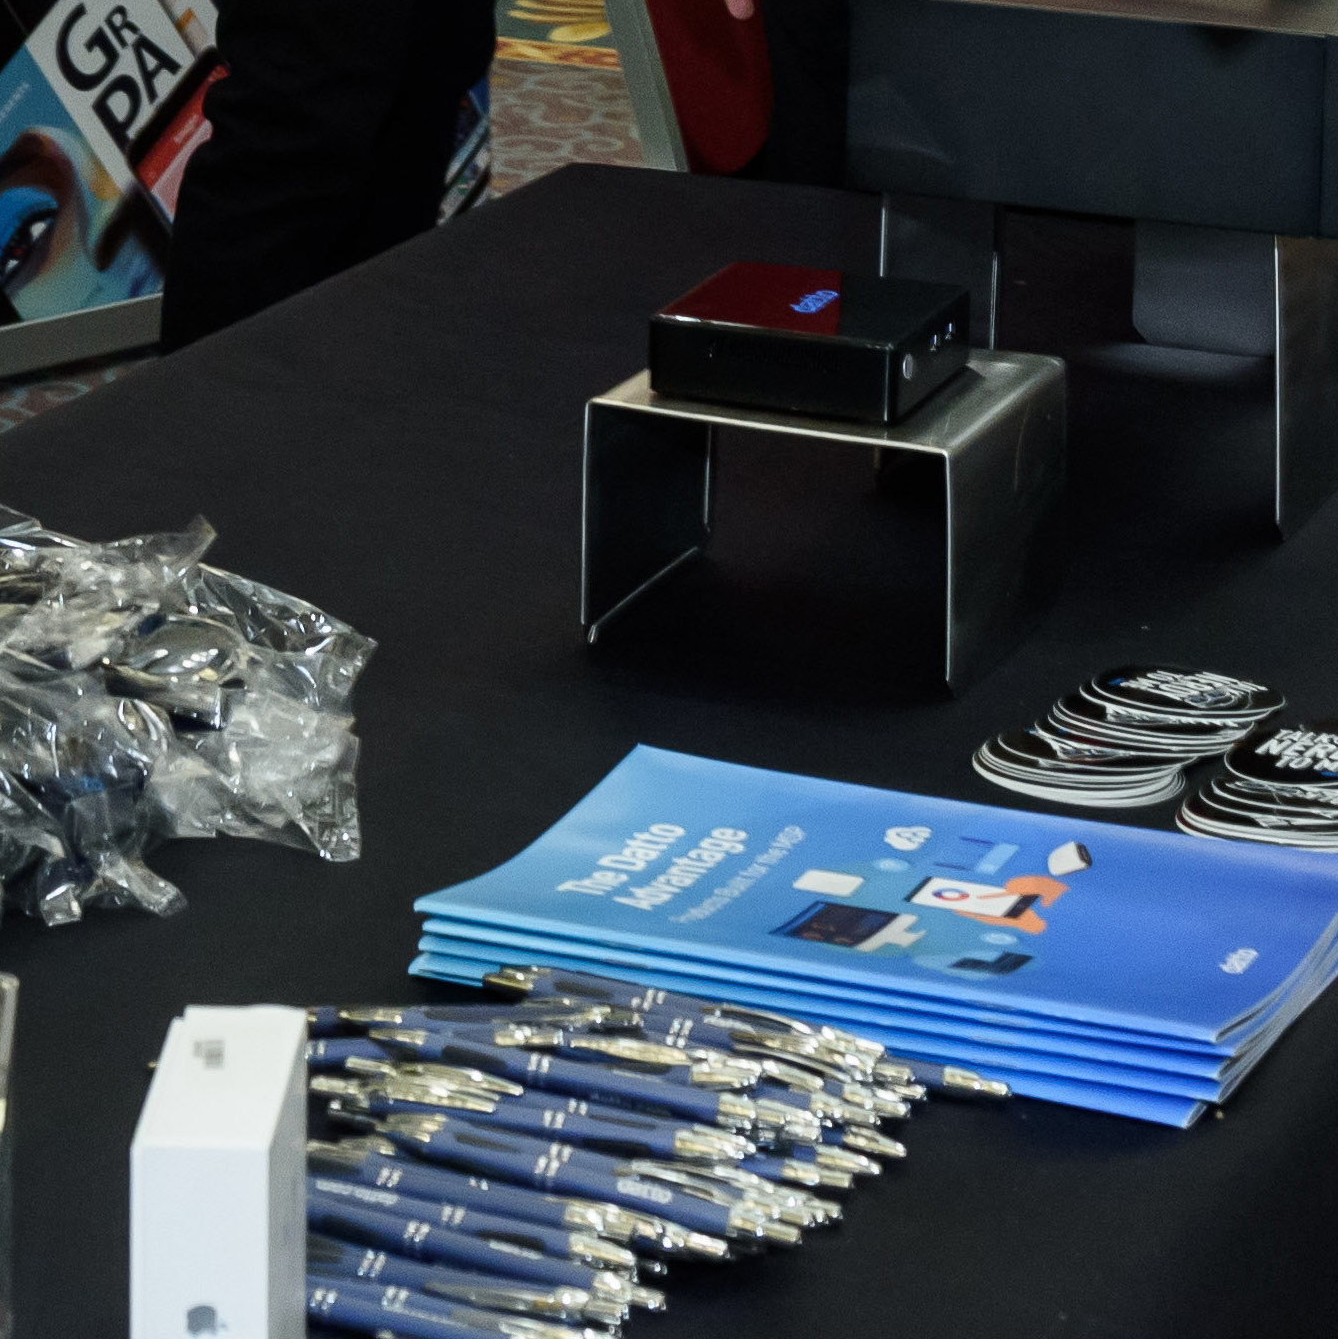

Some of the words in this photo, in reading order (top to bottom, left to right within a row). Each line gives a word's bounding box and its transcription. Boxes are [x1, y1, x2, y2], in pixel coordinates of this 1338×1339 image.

[1275, 755, 1311, 769] TO
[556, 870, 629, 895] The
[597, 823, 685, 871] Datto
[612, 827, 748, 911] Advantage
